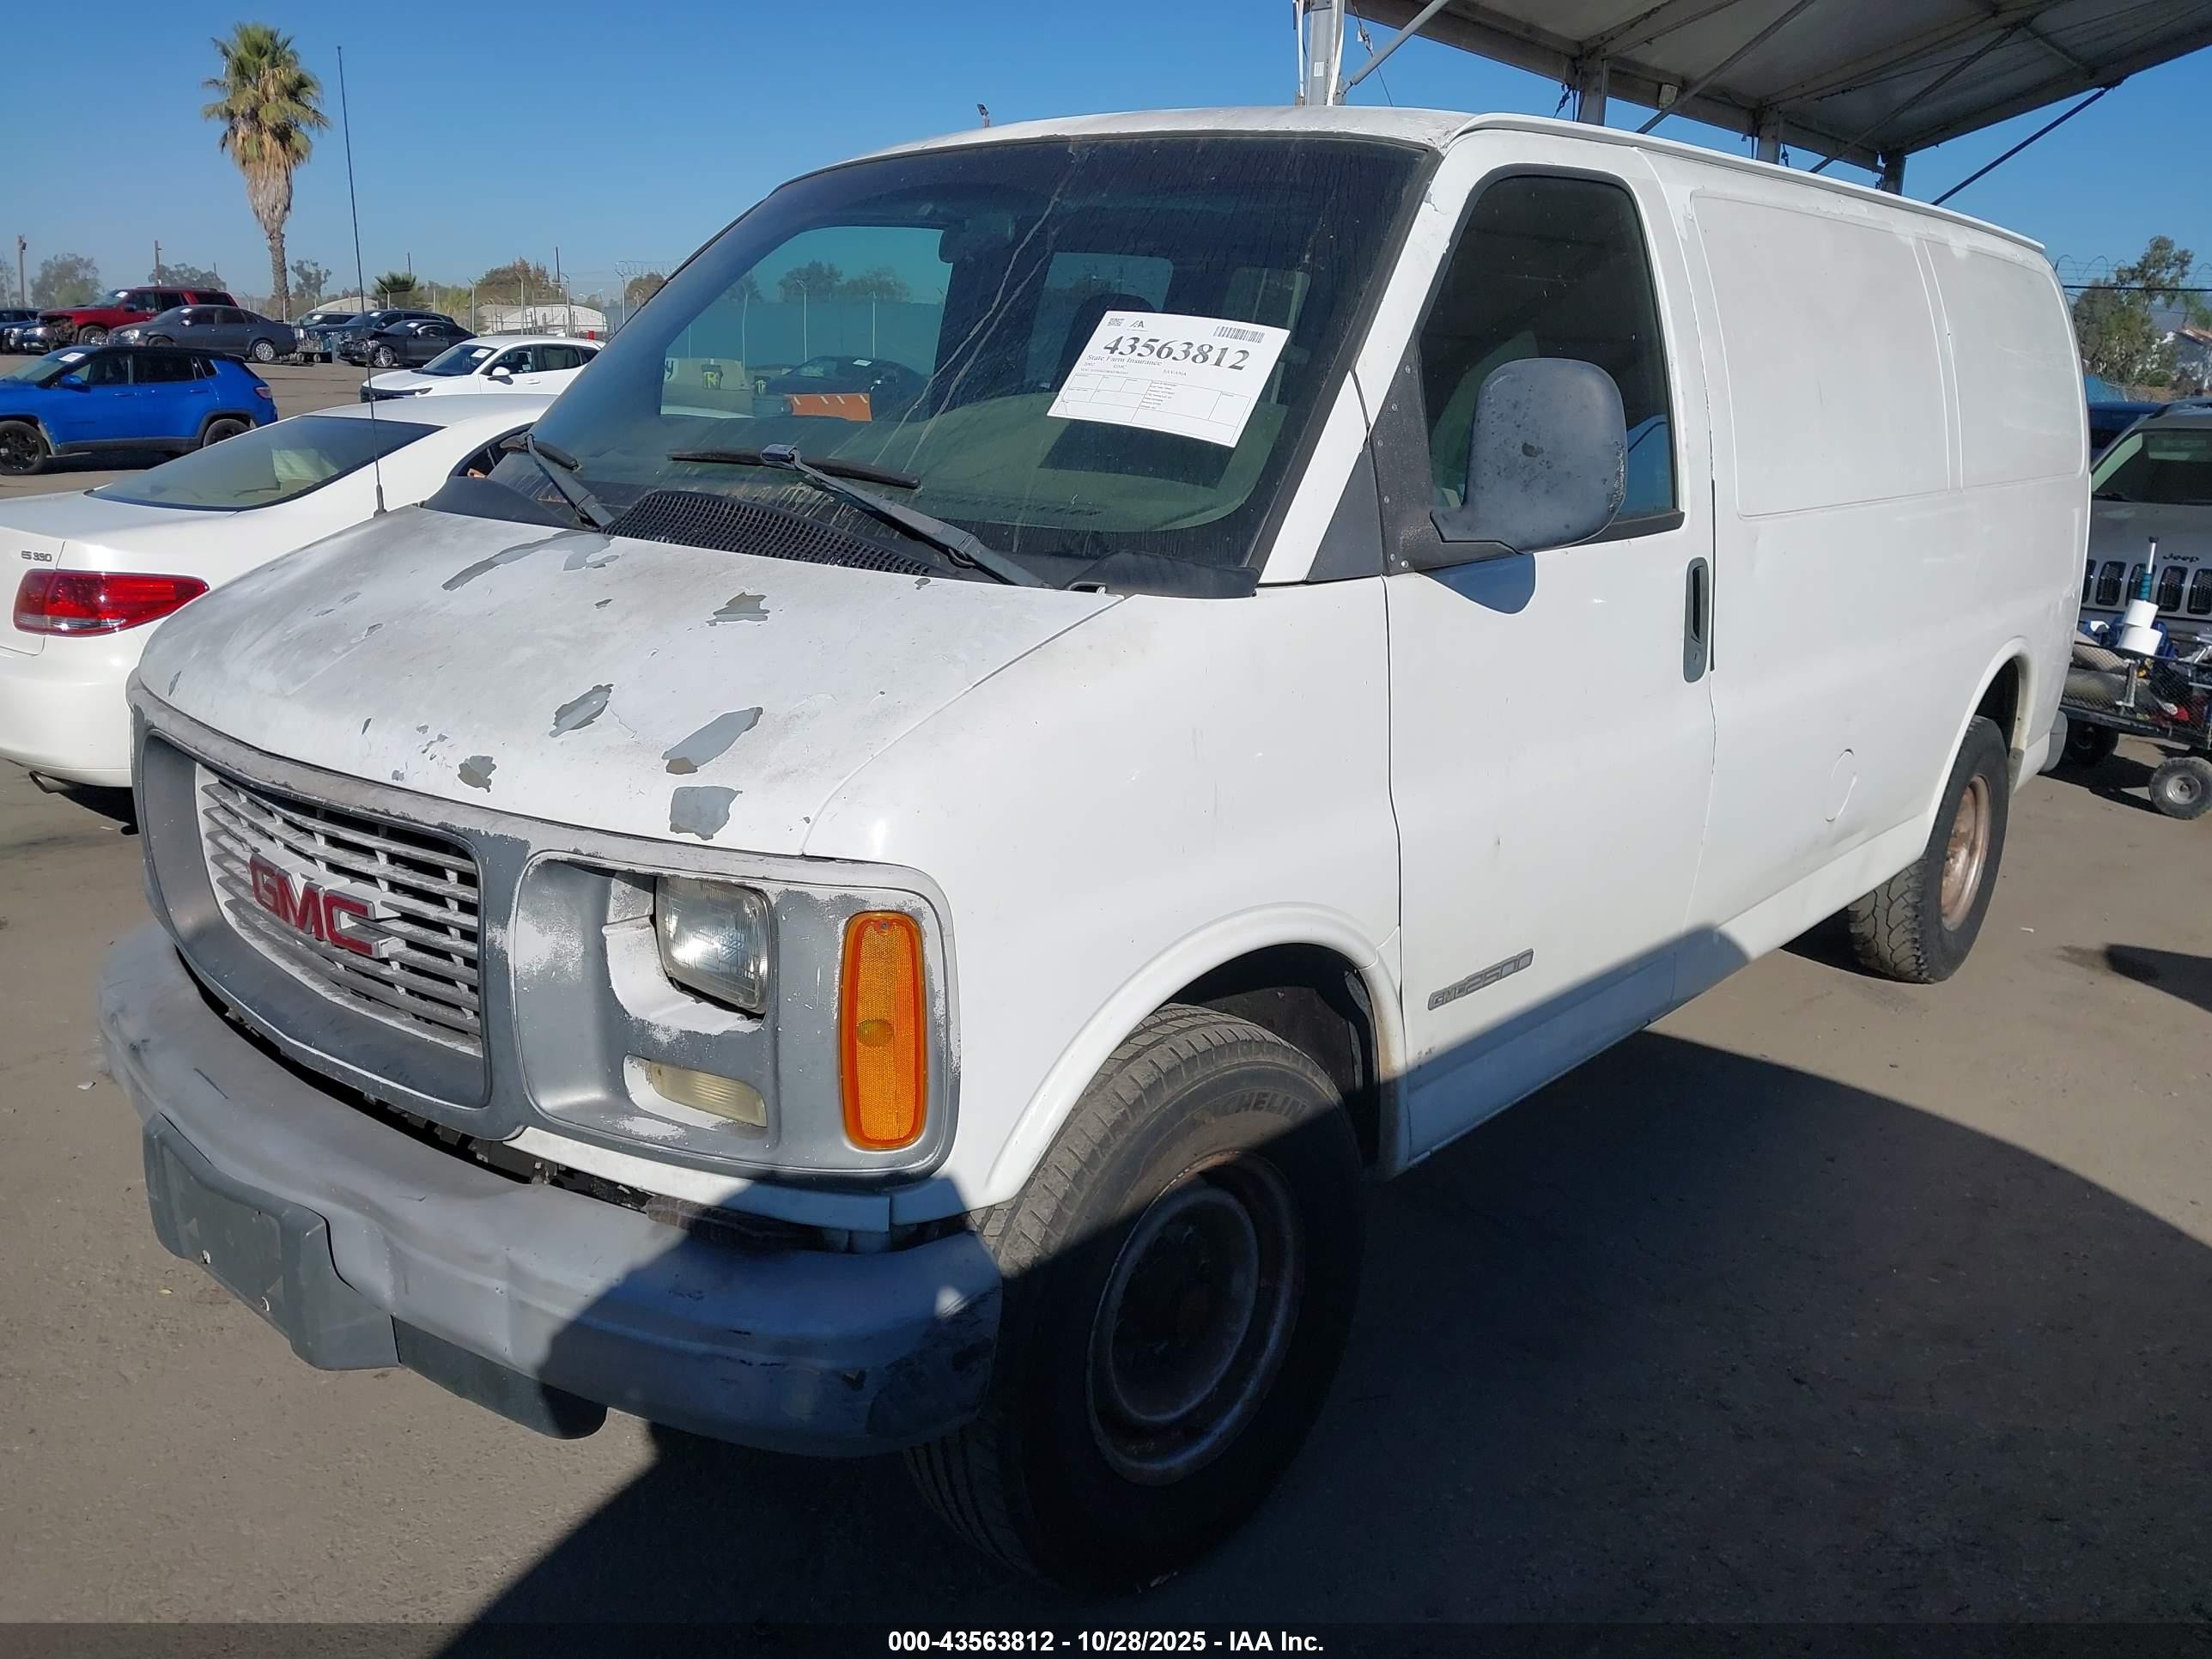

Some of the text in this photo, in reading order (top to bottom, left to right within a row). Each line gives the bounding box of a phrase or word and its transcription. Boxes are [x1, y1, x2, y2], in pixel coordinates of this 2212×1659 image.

[1103, 336, 1250, 370] 43563812
[1127, 357, 1163, 367] Insurance
[2162, 553, 2200, 563] Jeep
[249, 852, 380, 958] GMC
